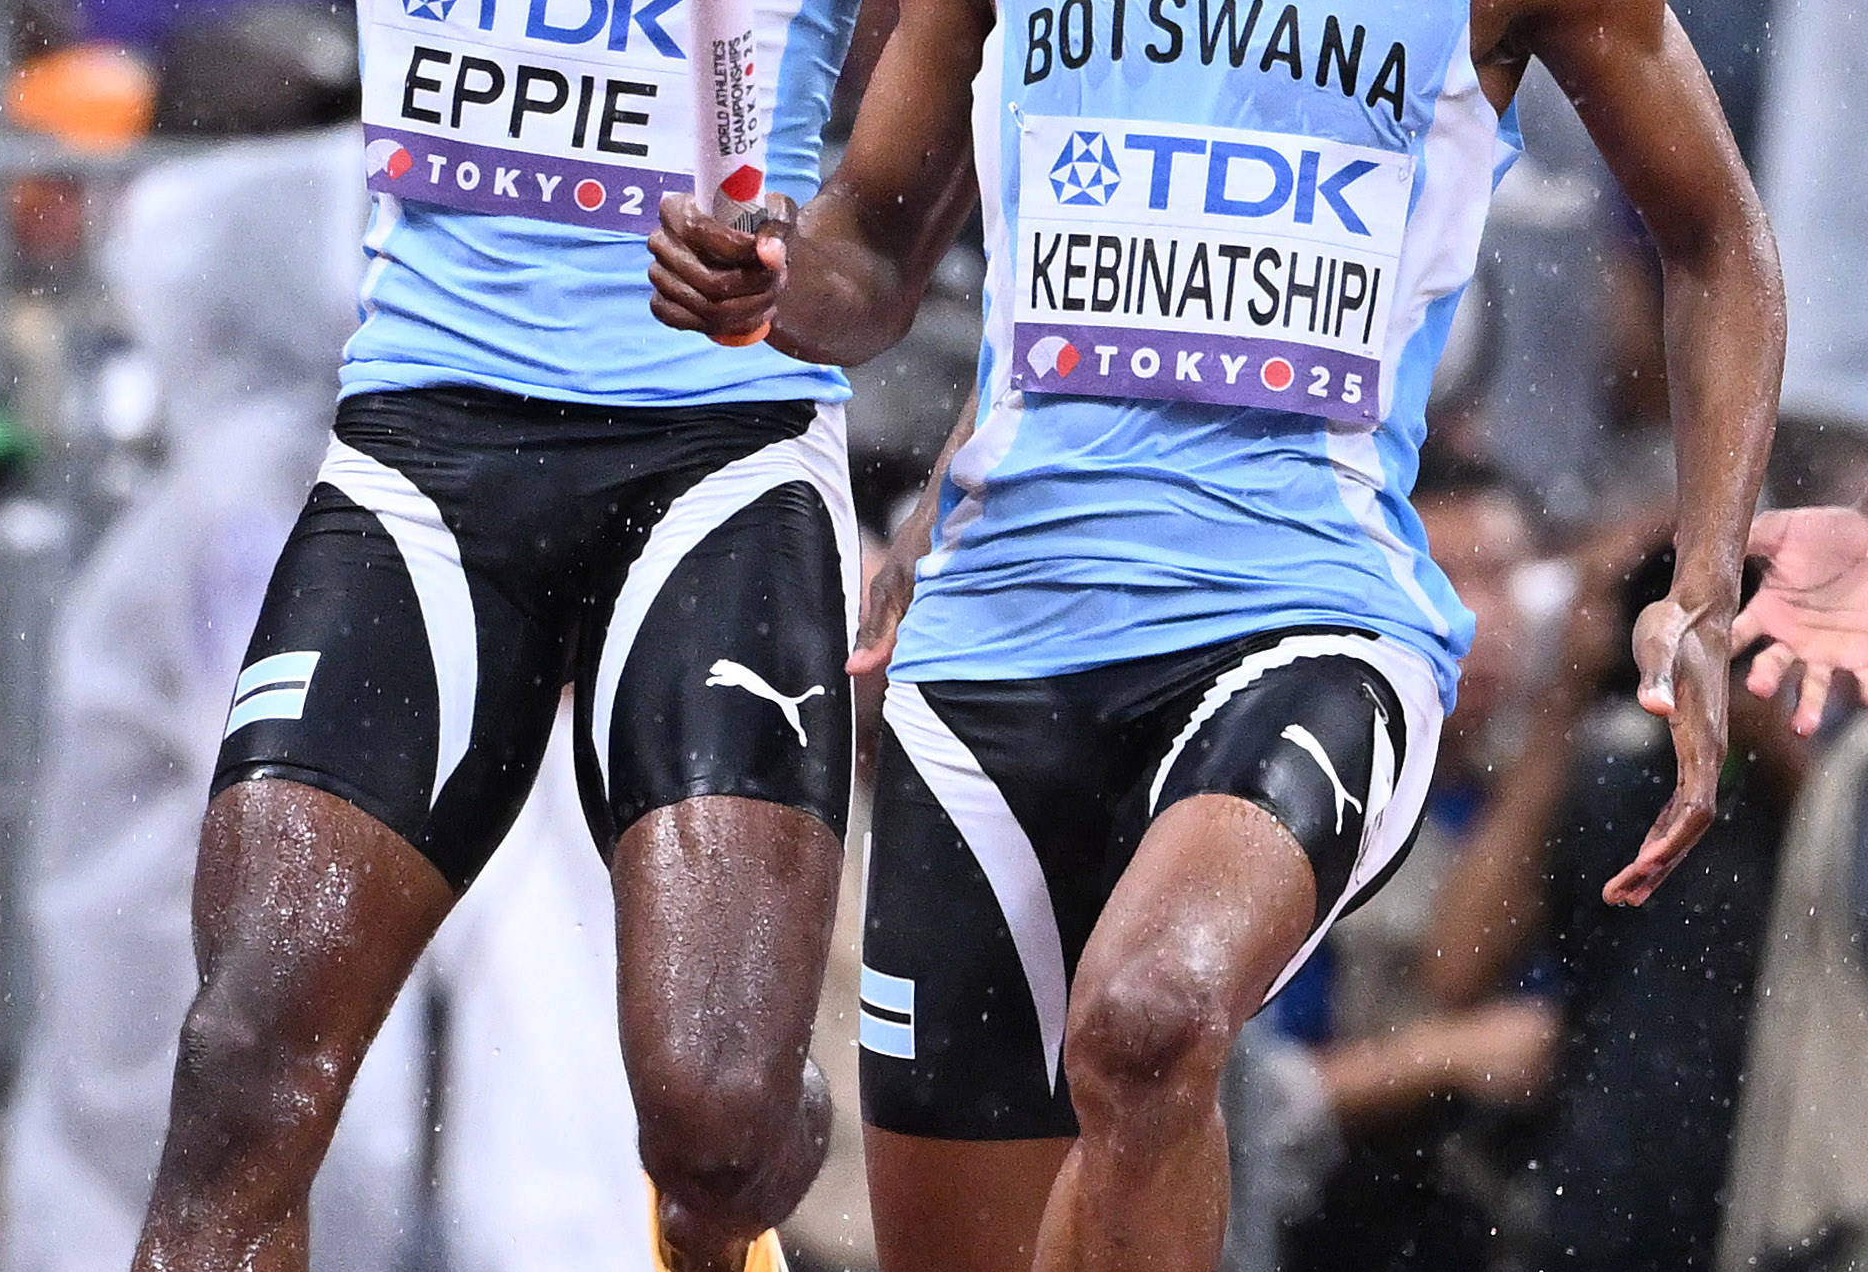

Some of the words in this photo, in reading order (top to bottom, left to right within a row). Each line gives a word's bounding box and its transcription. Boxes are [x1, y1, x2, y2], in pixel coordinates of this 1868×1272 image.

[401, 45, 658, 157] EPPIE
[712, 39, 729, 108] ATHLETICS
[728, 37, 748, 155] CHAMPIONSHIPS
[716, 110, 733, 157] WORLD
[1124, 133, 1381, 237] TDK
[1030, 231, 1381, 345] KEBINATSHIPI
